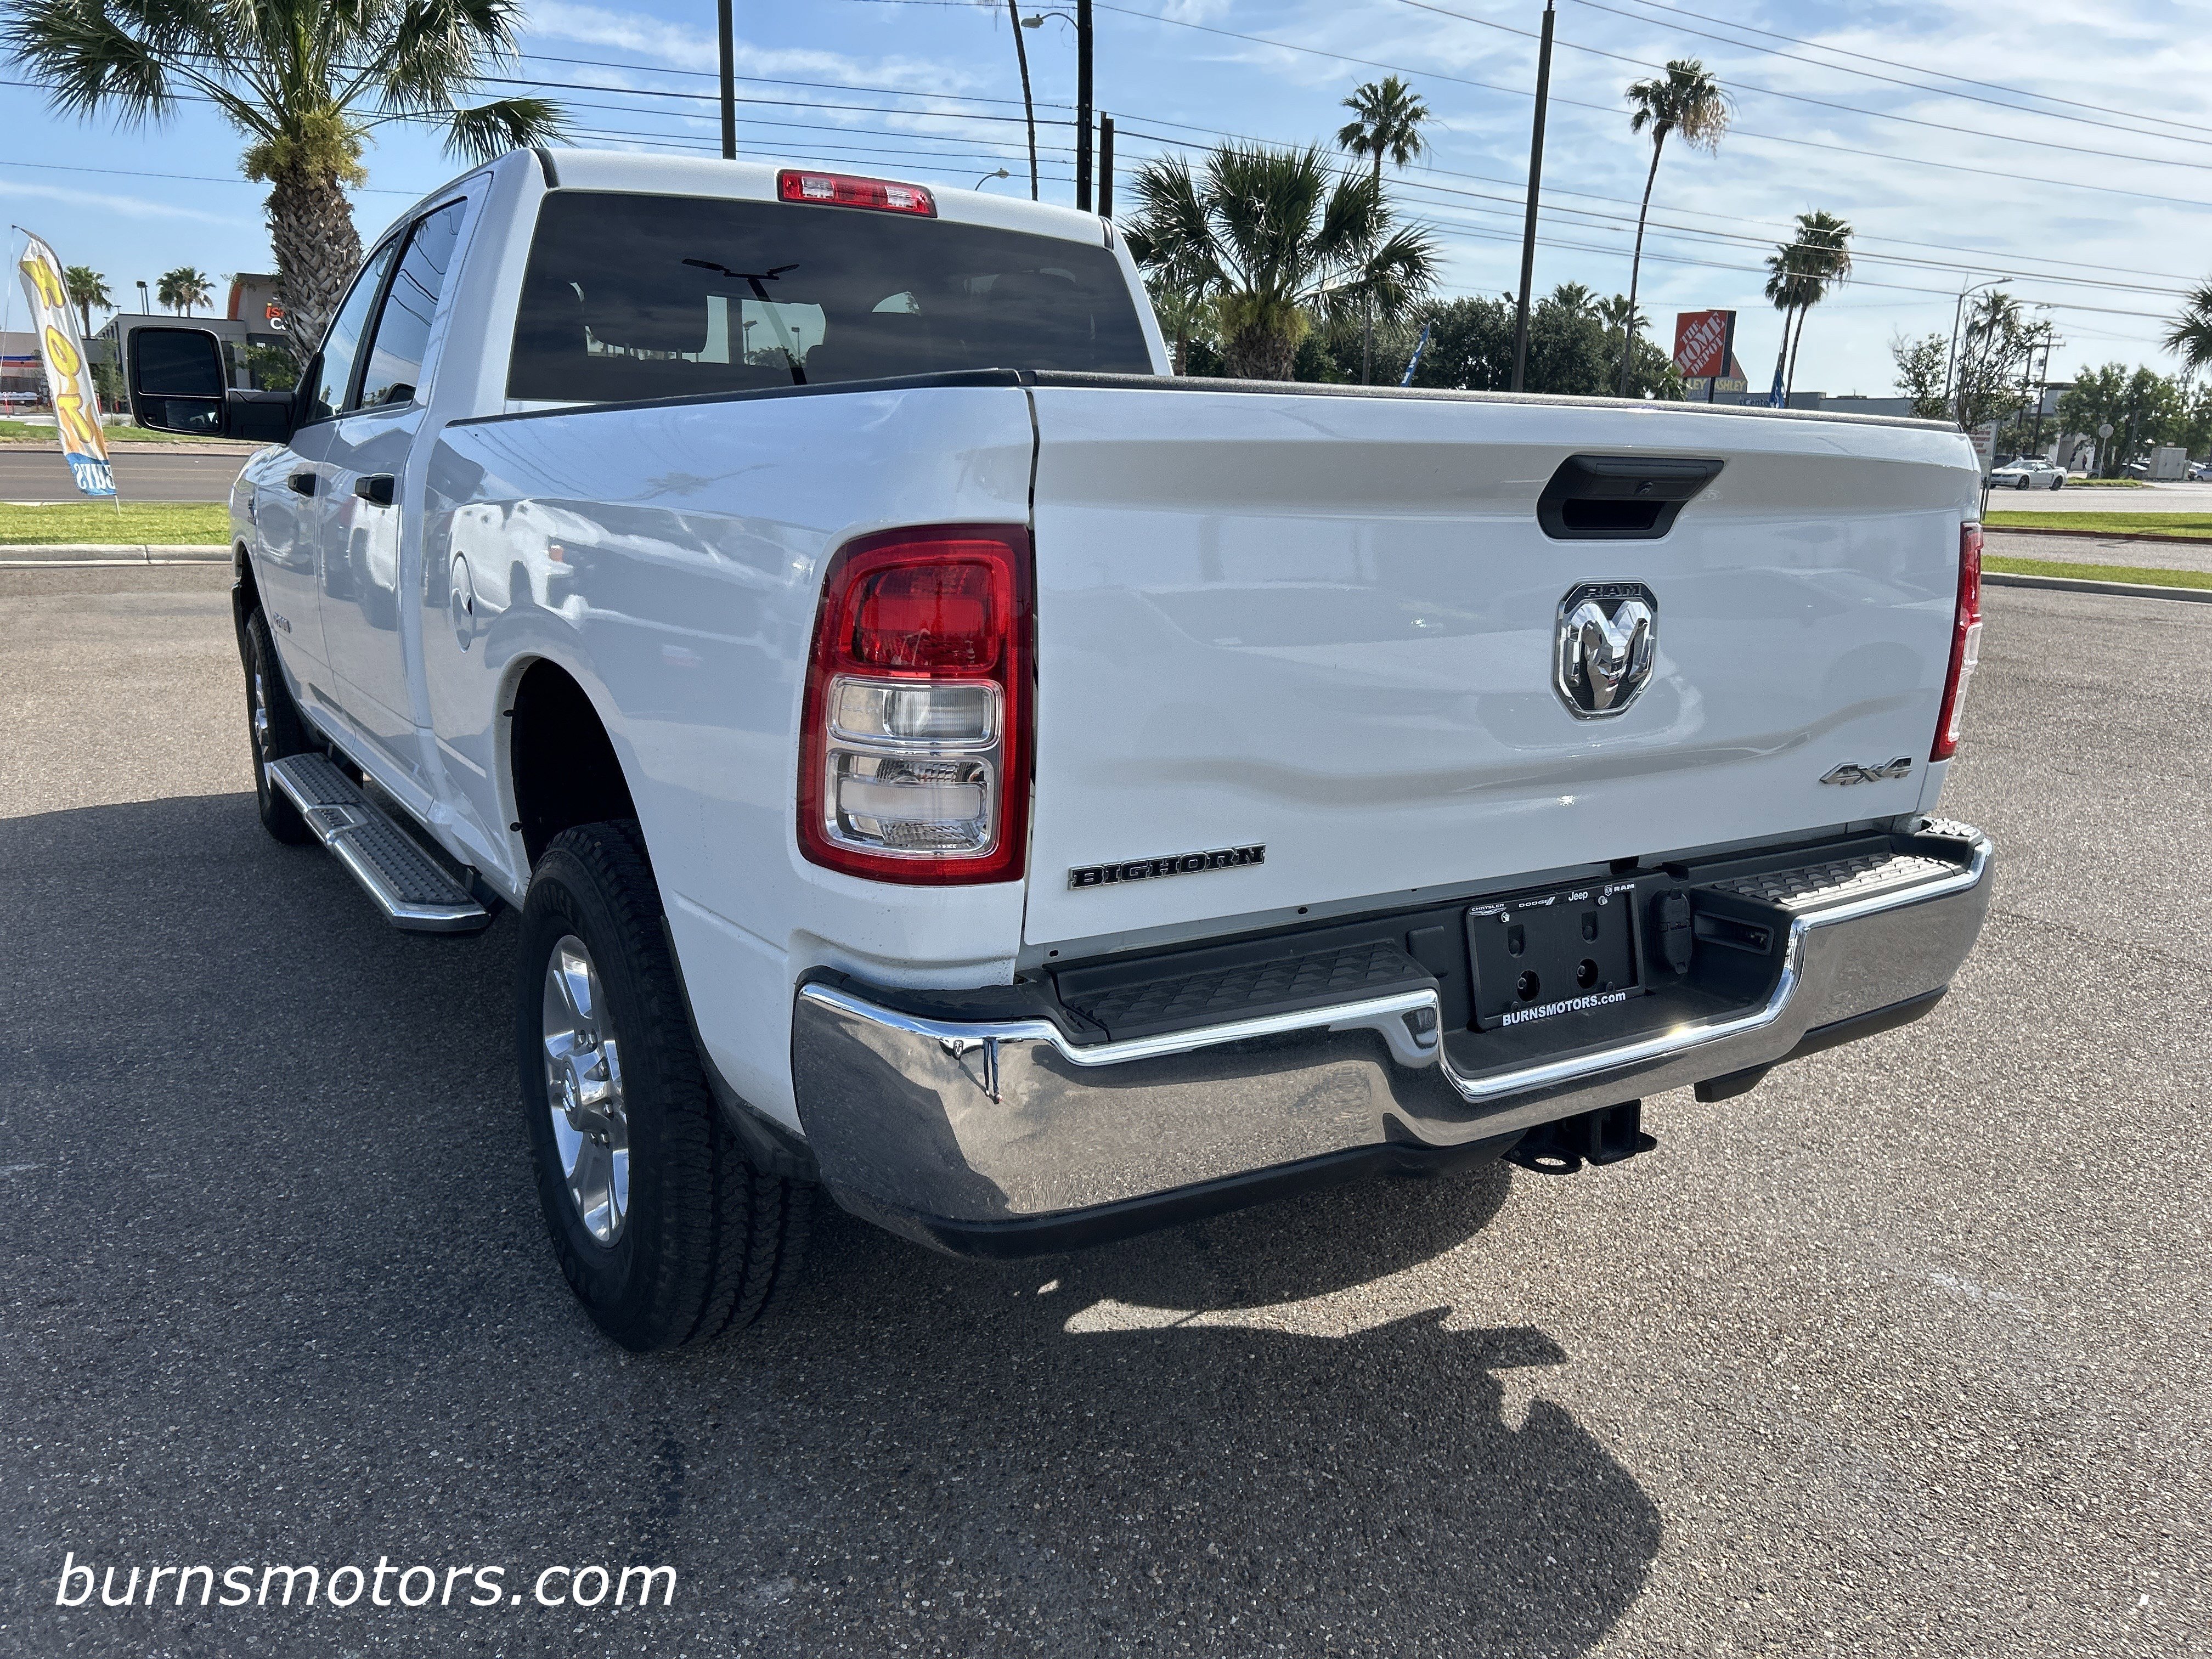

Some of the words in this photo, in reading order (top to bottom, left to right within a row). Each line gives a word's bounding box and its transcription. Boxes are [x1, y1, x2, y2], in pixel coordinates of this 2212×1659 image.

[1680, 320, 1701, 344] THE
[1673, 312, 1725, 377] HOME
[1691, 335, 1723, 375] DEPOT
[1715, 380, 1747, 391] ASHLEY
[1584, 584, 1642, 597] RAM
[1068, 843, 1266, 890] BIGHORN
[1568, 891, 1588, 901] Jeep
[1614, 883, 1635, 891] RAM
[1519, 899, 1549, 907] DODGE
[1503, 992, 1626, 1026] BURNSMOTORS.com
